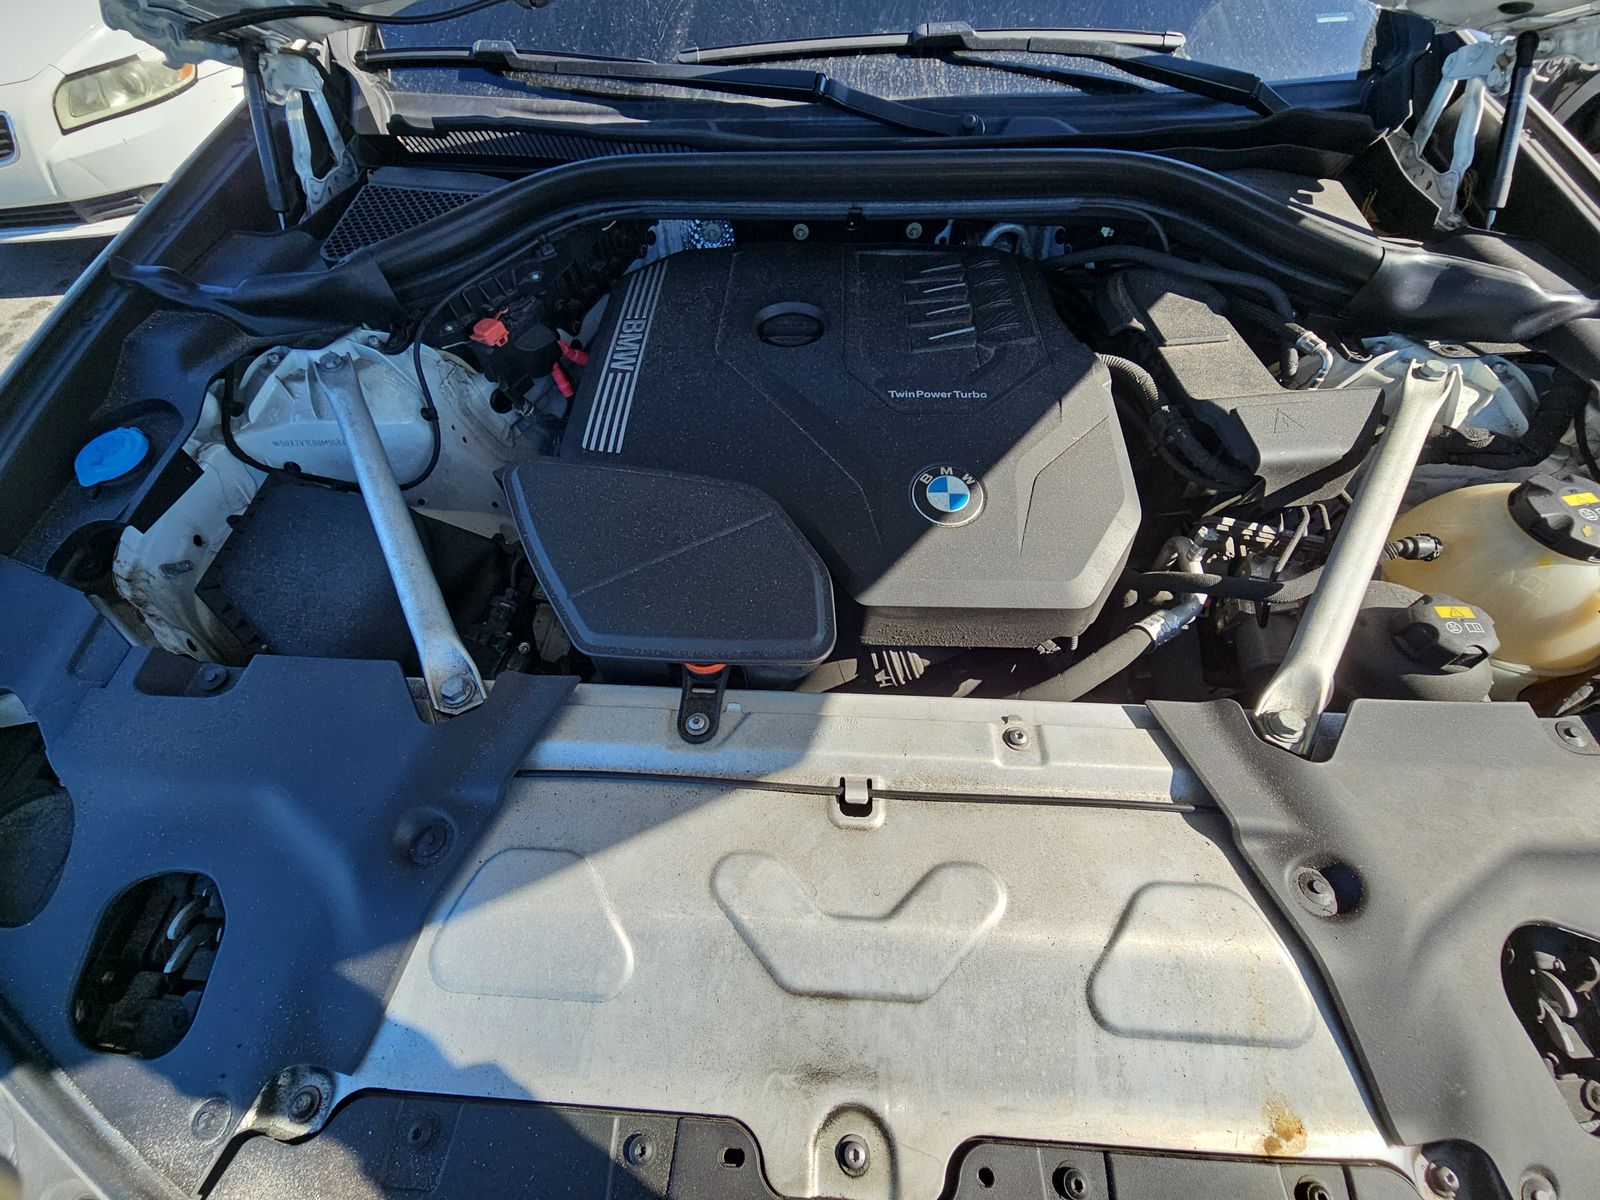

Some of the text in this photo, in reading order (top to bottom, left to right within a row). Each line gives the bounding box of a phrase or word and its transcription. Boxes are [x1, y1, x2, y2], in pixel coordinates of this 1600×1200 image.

[610, 318, 646, 371] BMW
[887, 389, 988, 399] TwinPower Turbo
[918, 466, 976, 486] BMW
